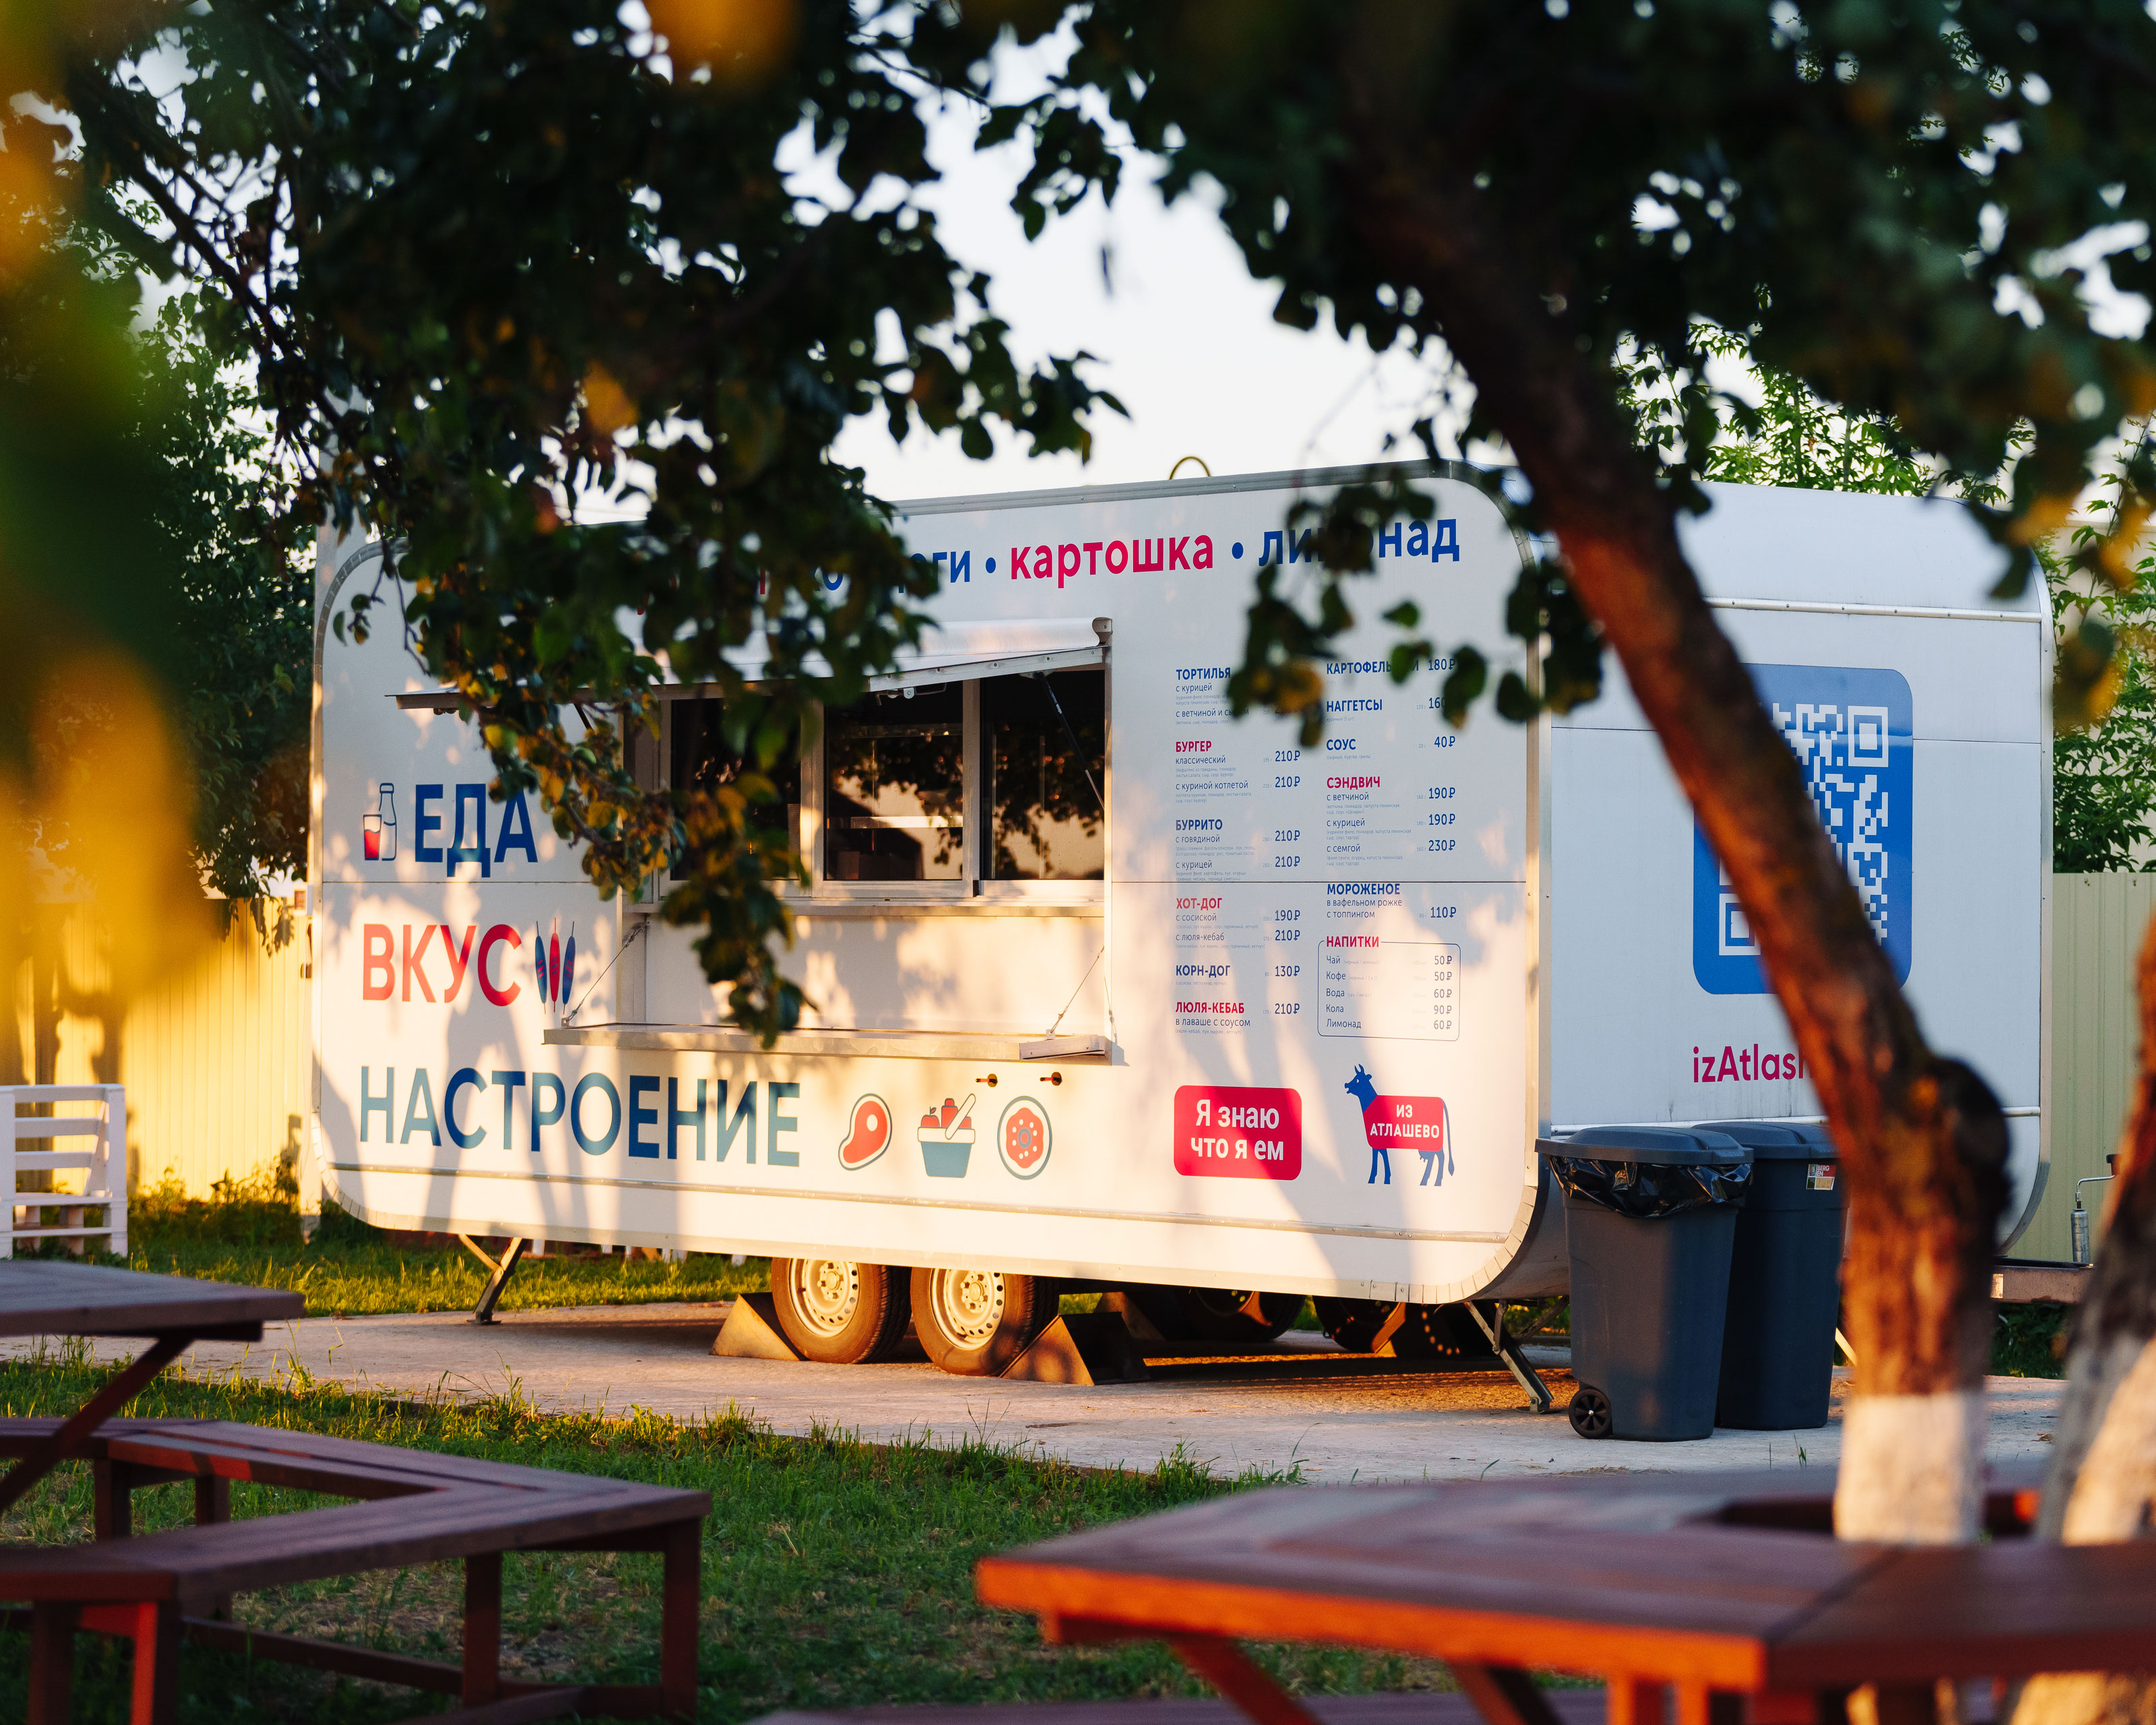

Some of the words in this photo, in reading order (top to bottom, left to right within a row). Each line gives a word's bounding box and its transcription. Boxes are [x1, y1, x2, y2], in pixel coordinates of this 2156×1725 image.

[1259, 518, 1460, 567] линад
[1011, 533, 1213, 589] картошка
[1176, 667, 1230, 680] ТОРТИЛЬЯ
[1182, 683, 1212, 693] курицей
[1327, 699, 1382, 712] НАГГЕТСЫ
[1182, 708, 1215, 717] ветчиной
[1176, 741, 1212, 753] БУРГЕР
[1327, 739, 1356, 751] СОУС
[1434, 736, 1456, 748] 40₽
[1176, 755, 1226, 764] классический
[1275, 750, 1300, 762] 210₽
[1182, 781, 1213, 792] куриной
[1215, 780, 1248, 790] котлетой
[1275, 776, 1300, 788] 210₽
[1327, 776, 1381, 790] СЭНДВИЧ
[1333, 792, 1369, 801] ветчиной
[1428, 787, 1456, 799] 190₽
[1176, 819, 1223, 830] БУРРИТО
[1333, 818, 1365, 829] курицей
[1428, 813, 1456, 825] 190₽
[414, 782, 538, 877] ЕДА
[1182, 834, 1220, 844] говядиной
[1275, 830, 1300, 842] 210₽
[1333, 844, 1360, 852] семгой
[1428, 840, 1456, 851] 230₽
[1182, 860, 1212, 871] курицей
[1275, 856, 1300, 867] 210₽
[1327, 883, 1400, 895] МОРОЖЕНОЕ
[1176, 898, 1222, 910] ХОТ-ДОГ
[1333, 898, 1375, 908] вафельном
[1378, 900, 1402, 908] рожке
[1182, 913, 1217, 921] сосиской
[1275, 910, 1300, 921] 190₽
[1430, 906, 1456, 918] 110₽
[1182, 932, 1225, 941] люля-кебаб
[1275, 929, 1300, 941] 210₽
[1327, 936, 1379, 947] НАПИТКИ
[362, 923, 522, 1007] ВКУС
[1326, 955, 1341, 964] Чай
[1176, 965, 1230, 978] КОРН-ДОГ
[1275, 966, 1300, 977] 130₽
[1326, 971, 1346, 982] Кофе
[1326, 988, 1345, 997] Вода
[1176, 1002, 1244, 1013] ЛЮЛЯ-КЕБАБ
[1275, 1003, 1300, 1014] 210₽
[1326, 1004, 1344, 1013] Кола
[1182, 1018, 1211, 1026] лаваше
[1220, 1019, 1250, 1029] соусом
[1326, 1019, 1362, 1029] Лимонад
[360, 1065, 800, 1168] НАСТРОЕНИЕ
[1196, 1099, 1211, 1126] Я
[1217, 1107, 1279, 1129] знаю
[1396, 1104, 1413, 1118] ИЗ
[1370, 1123, 1440, 1139] АТЛАШЕВО
[1191, 1137, 1228, 1158] что
[1235, 1139, 1248, 1159] я
[1254, 1140, 1283, 1161] ем
